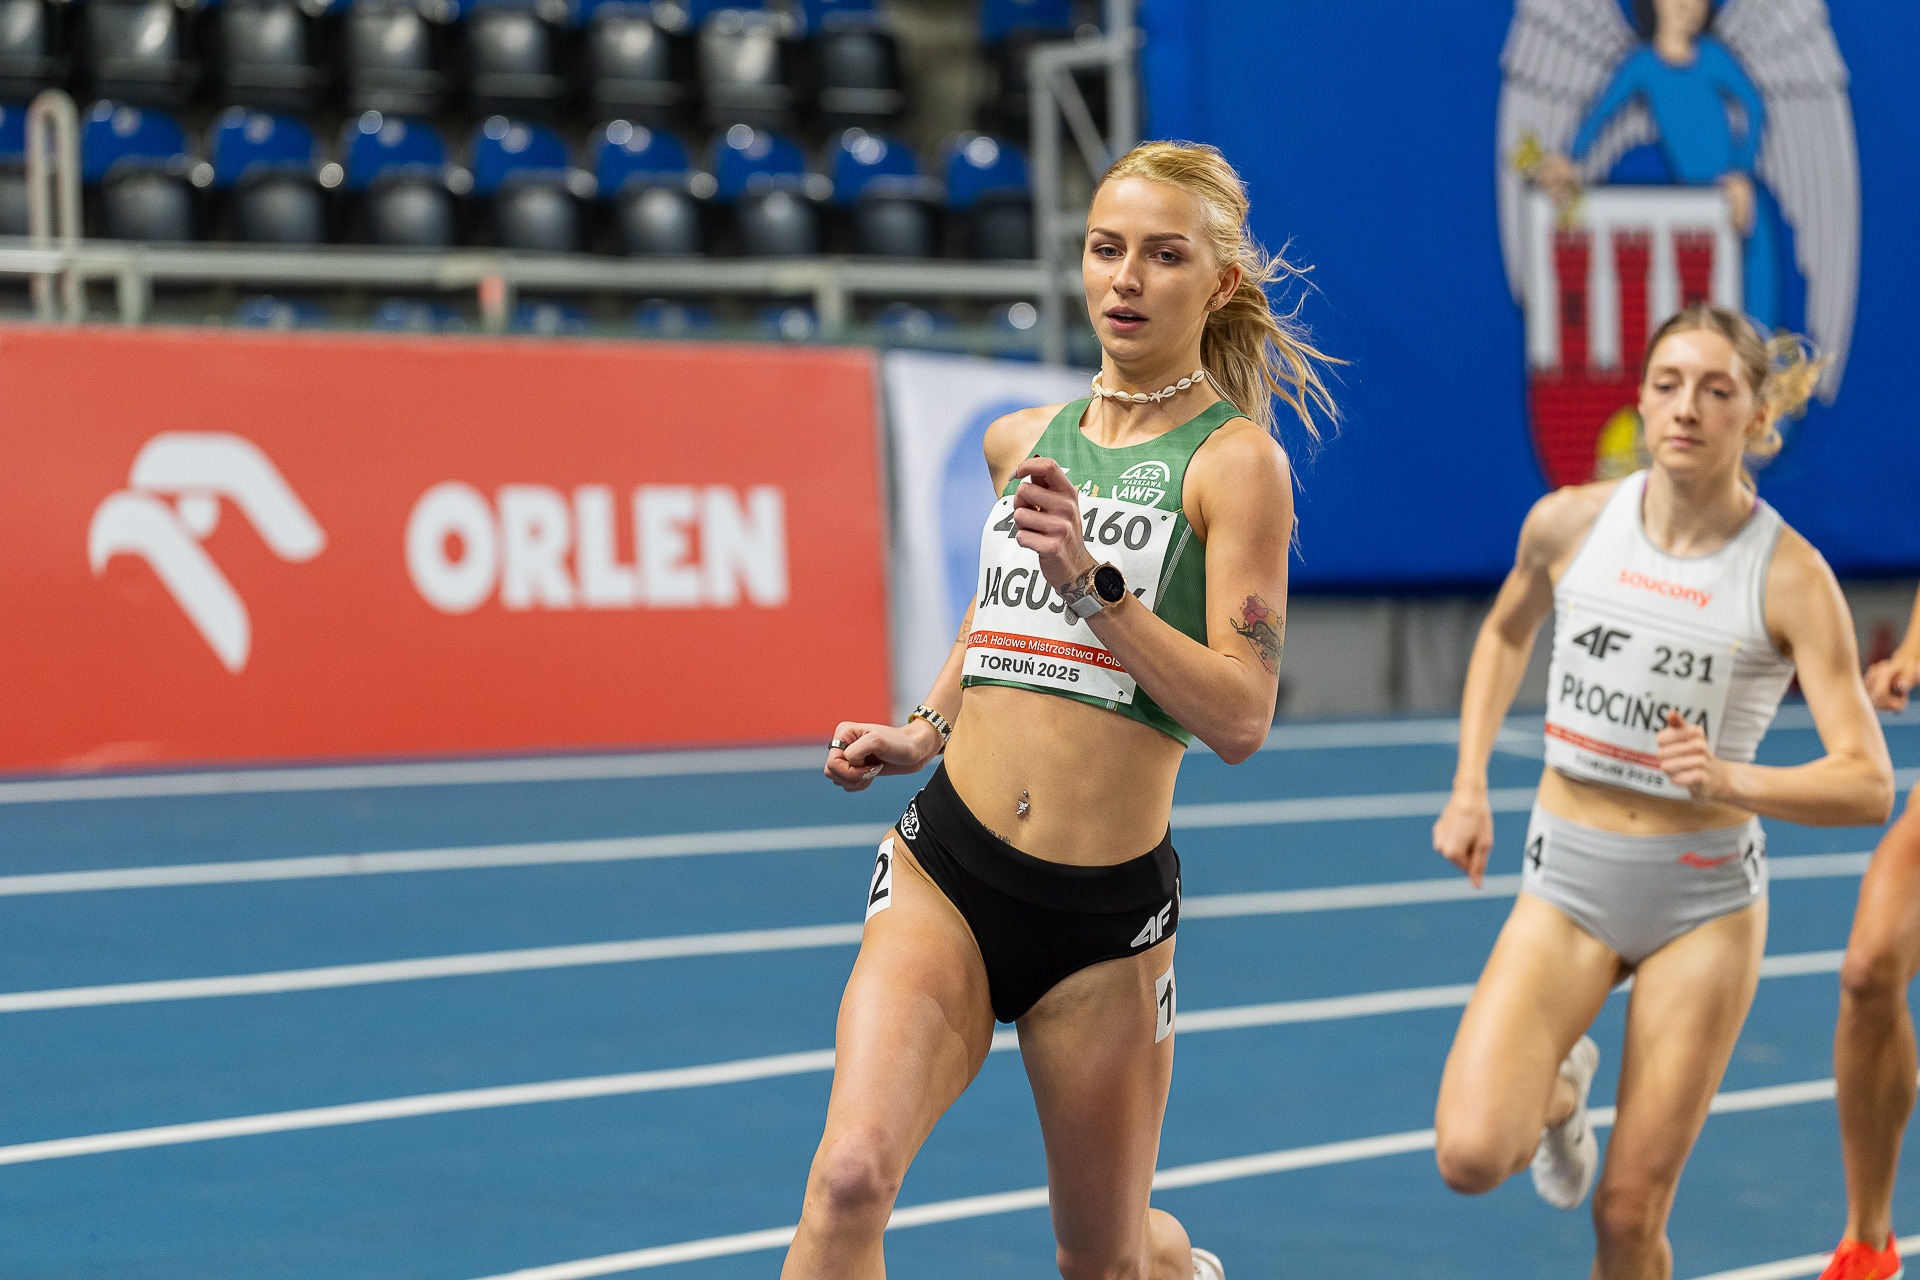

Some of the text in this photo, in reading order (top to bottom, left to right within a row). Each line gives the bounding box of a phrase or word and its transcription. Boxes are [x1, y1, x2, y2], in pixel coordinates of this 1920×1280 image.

[1121, 479, 1162, 489] WARSZAWA
[1130, 467, 1163, 481] AZS
[1117, 486, 1155, 502] AWF
[405, 481, 788, 615] ORLEN
[1082, 507, 1152, 551] 160
[1616, 567, 1713, 609] saucony
[973, 634, 988, 645] PZLA
[990, 635, 1026, 649] Halowe
[1028, 638, 1093, 661] Mistrzostwa
[1572, 622, 1713, 684] 4F 231
[980, 654, 1080, 683] TORUŃ 2025
[1525, 835, 1544, 871] 4
[868, 852, 889, 907] 2
[1130, 899, 1172, 948] 4F
